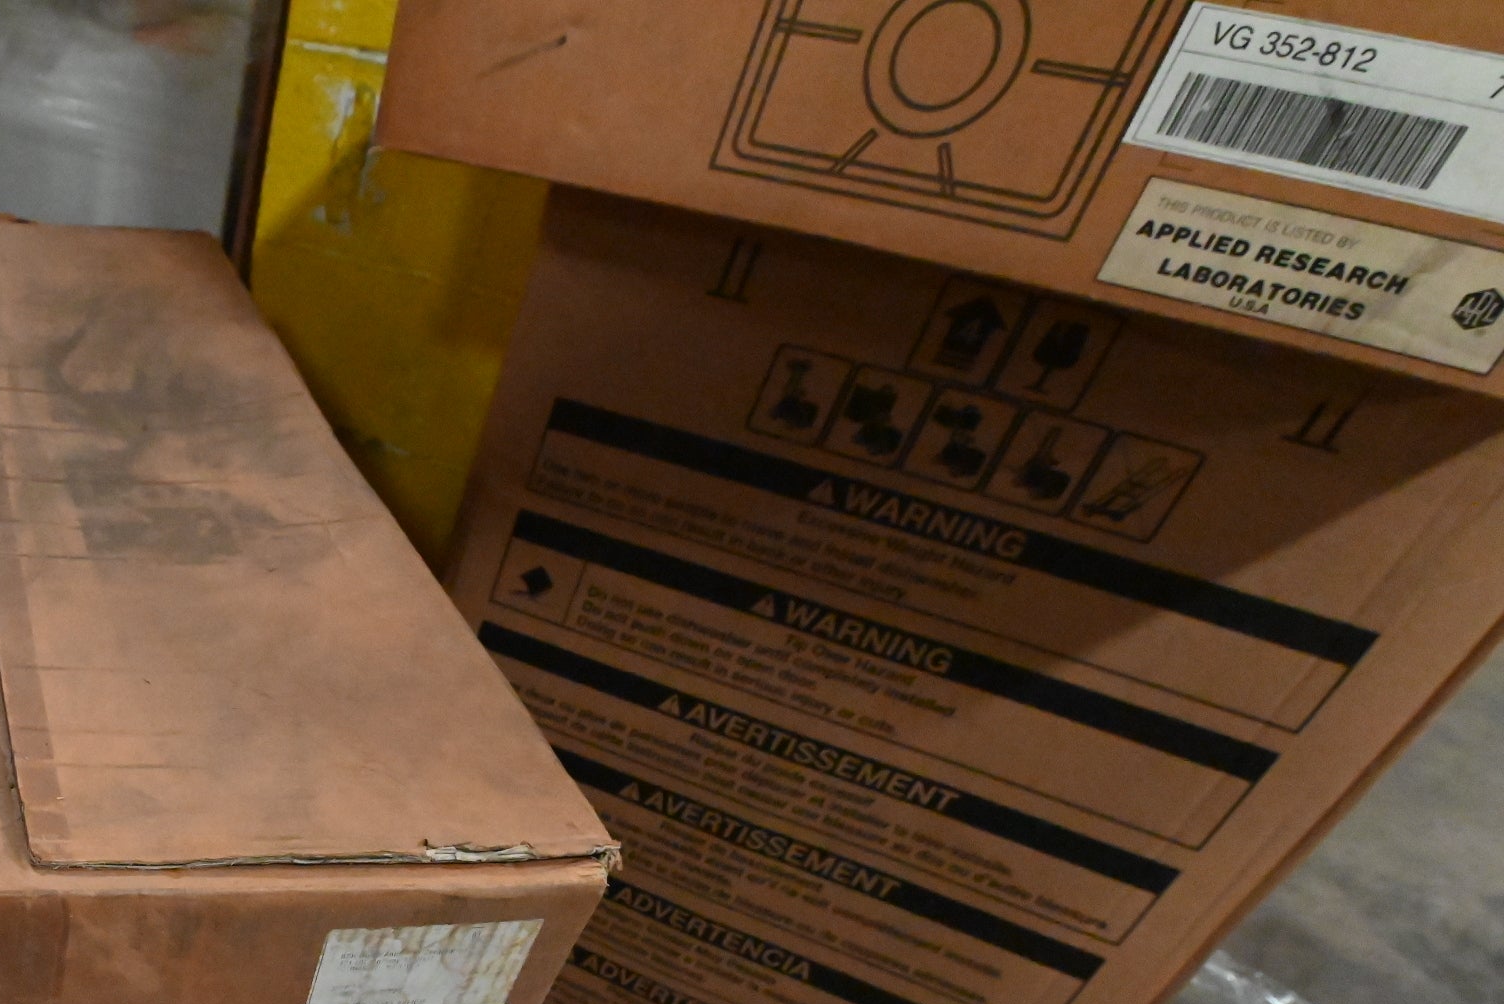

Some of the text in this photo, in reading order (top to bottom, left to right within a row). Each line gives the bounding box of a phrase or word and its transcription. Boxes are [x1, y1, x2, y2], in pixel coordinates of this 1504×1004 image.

[1213, 21, 1378, 74] VG 352-812
[1136, 219, 1410, 295] APPLIED RESEARCH
[1157, 257, 1366, 321] LABORATORIES
[845, 483, 1027, 560] WARNING
[785, 601, 953, 673] WARNING
[685, 702, 960, 812] AVERTISSEMENT
[645, 791, 900, 899] AVERTISSEMENT
[614, 886, 811, 981] ADVERTENCIA
